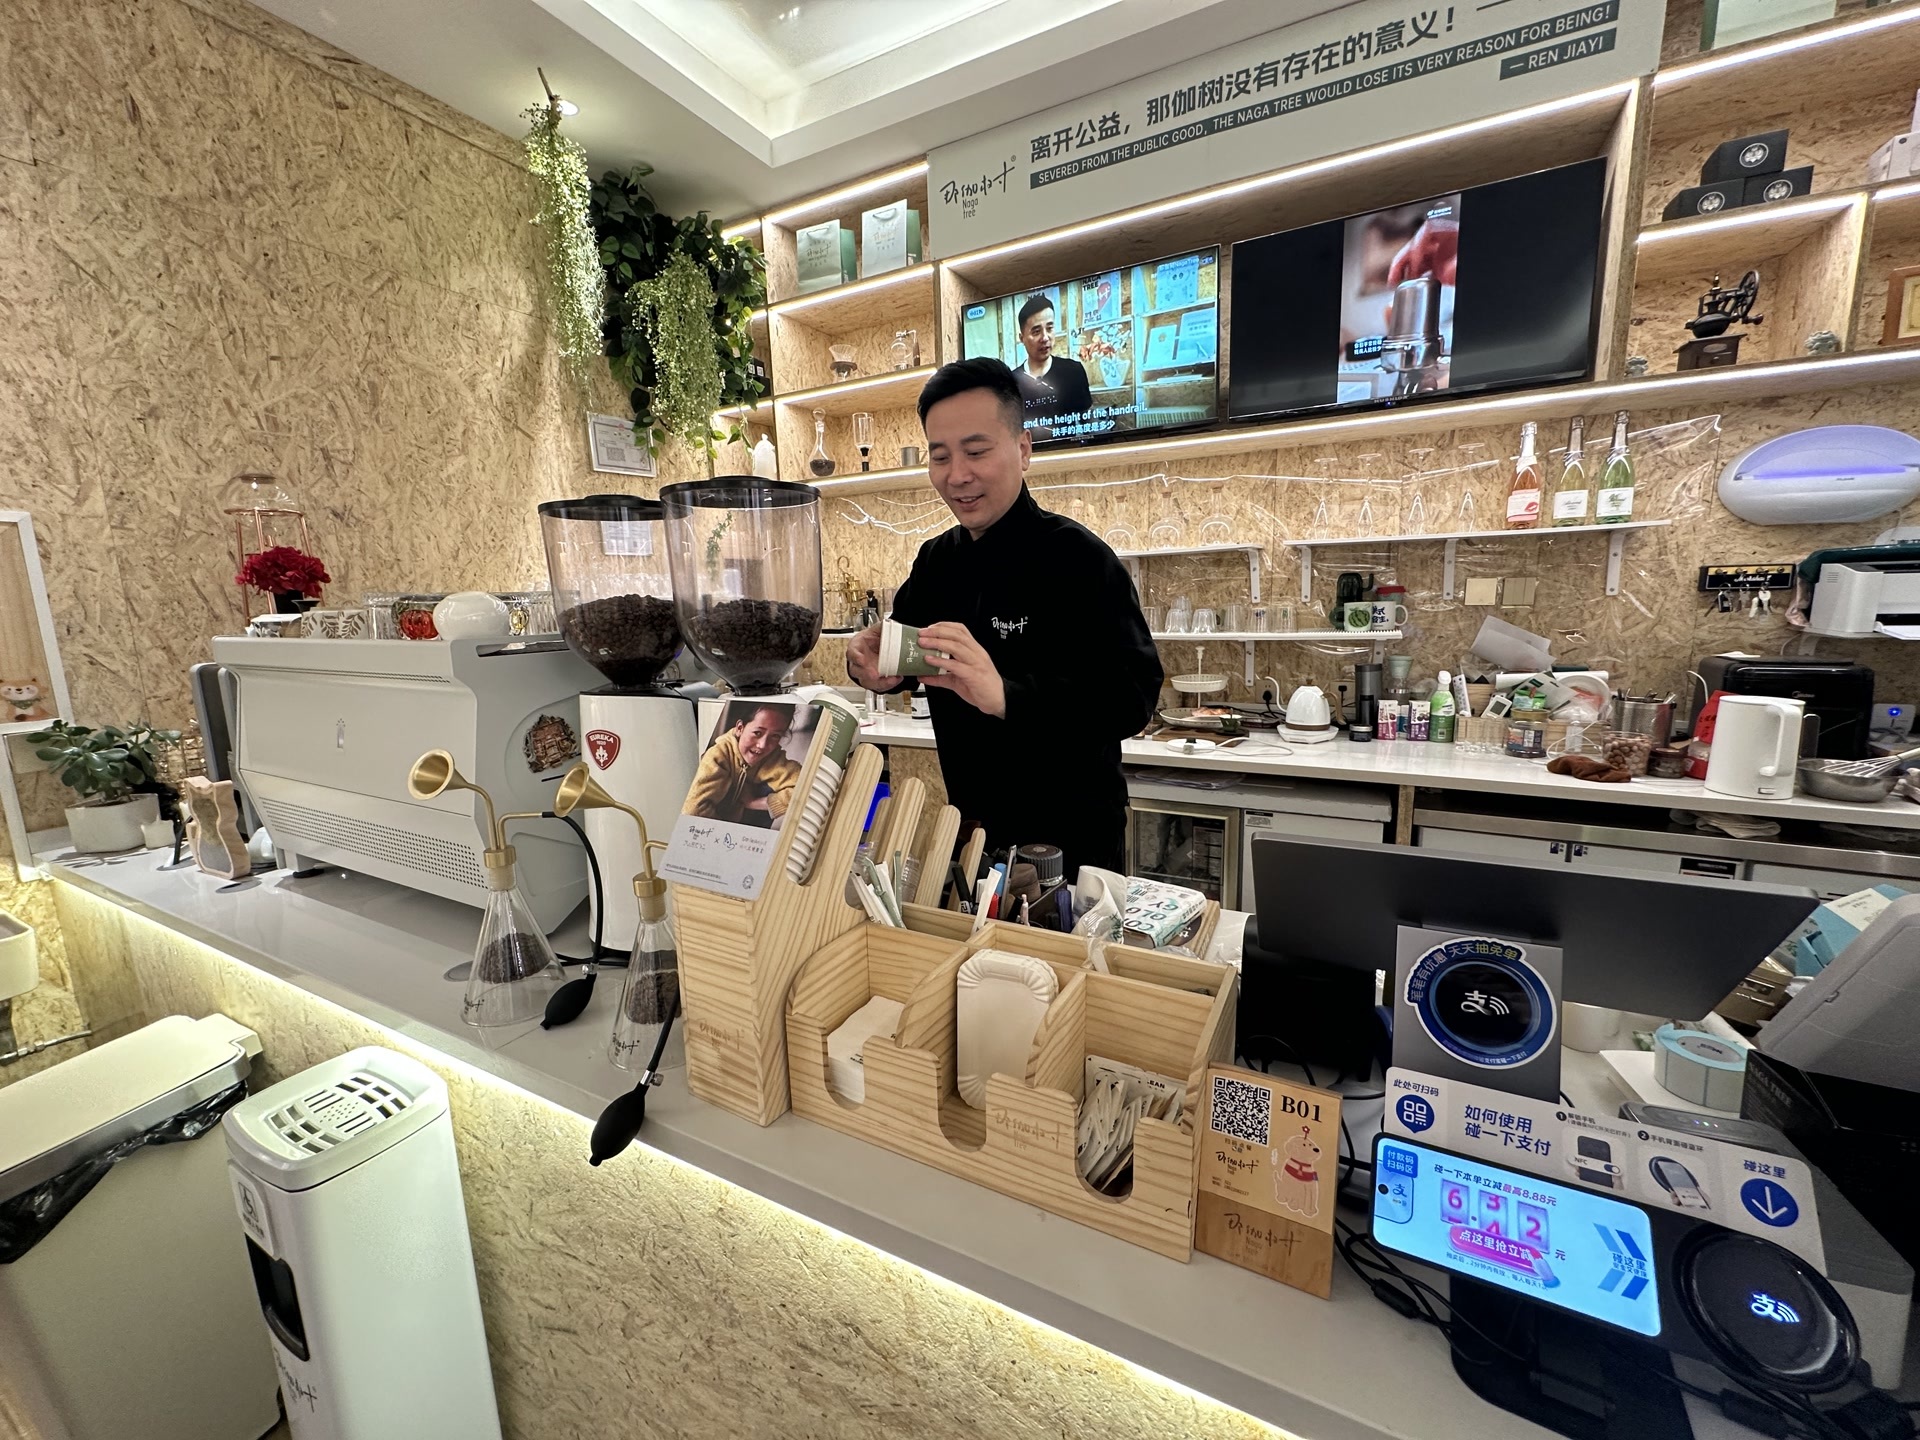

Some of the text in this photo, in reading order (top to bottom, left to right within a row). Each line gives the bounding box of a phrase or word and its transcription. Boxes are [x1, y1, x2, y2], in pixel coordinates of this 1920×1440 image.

[1528, 49, 1558, 69] REN
[1563, 36, 1604, 60] JIAYI
[1038, 7, 1610, 185] SEVERED FROM THE PUBLIC GOOD, THE NAGA TREE WOULD LOSE ITS VERY REASON FOR BEING!
[962, 197, 979, 210] Naga
[963, 208, 976, 219] tree
[1082, 281, 1099, 291] TREE
[1023, 403, 1148, 429] and the height of the handrail.
[1052, 420, 1115, 437] 扶手的高度是多少
[589, 733, 614, 744] EUREKA
[1448, 942, 1518, 961] 天天抽免单
[1393, 1079, 1439, 1097] 此处可扫码
[1280, 1095, 1322, 1123] B01
[1464, 1104, 1532, 1134] 如何使用
[1464, 1122, 1552, 1156] 碰一下支付
[1387, 1150, 1414, 1165] 付款码
[1387, 1159, 1413, 1174] 扫码区
[1574, 1156, 1588, 1165] NFC
[1743, 1159, 1787, 1180] 碰这里
[1434, 1163, 1557, 1206] 碰一下本单立减最高8.88元
[1555, 1249, 1566, 1261] 元
[1612, 1252, 1647, 1271] 碰这里
